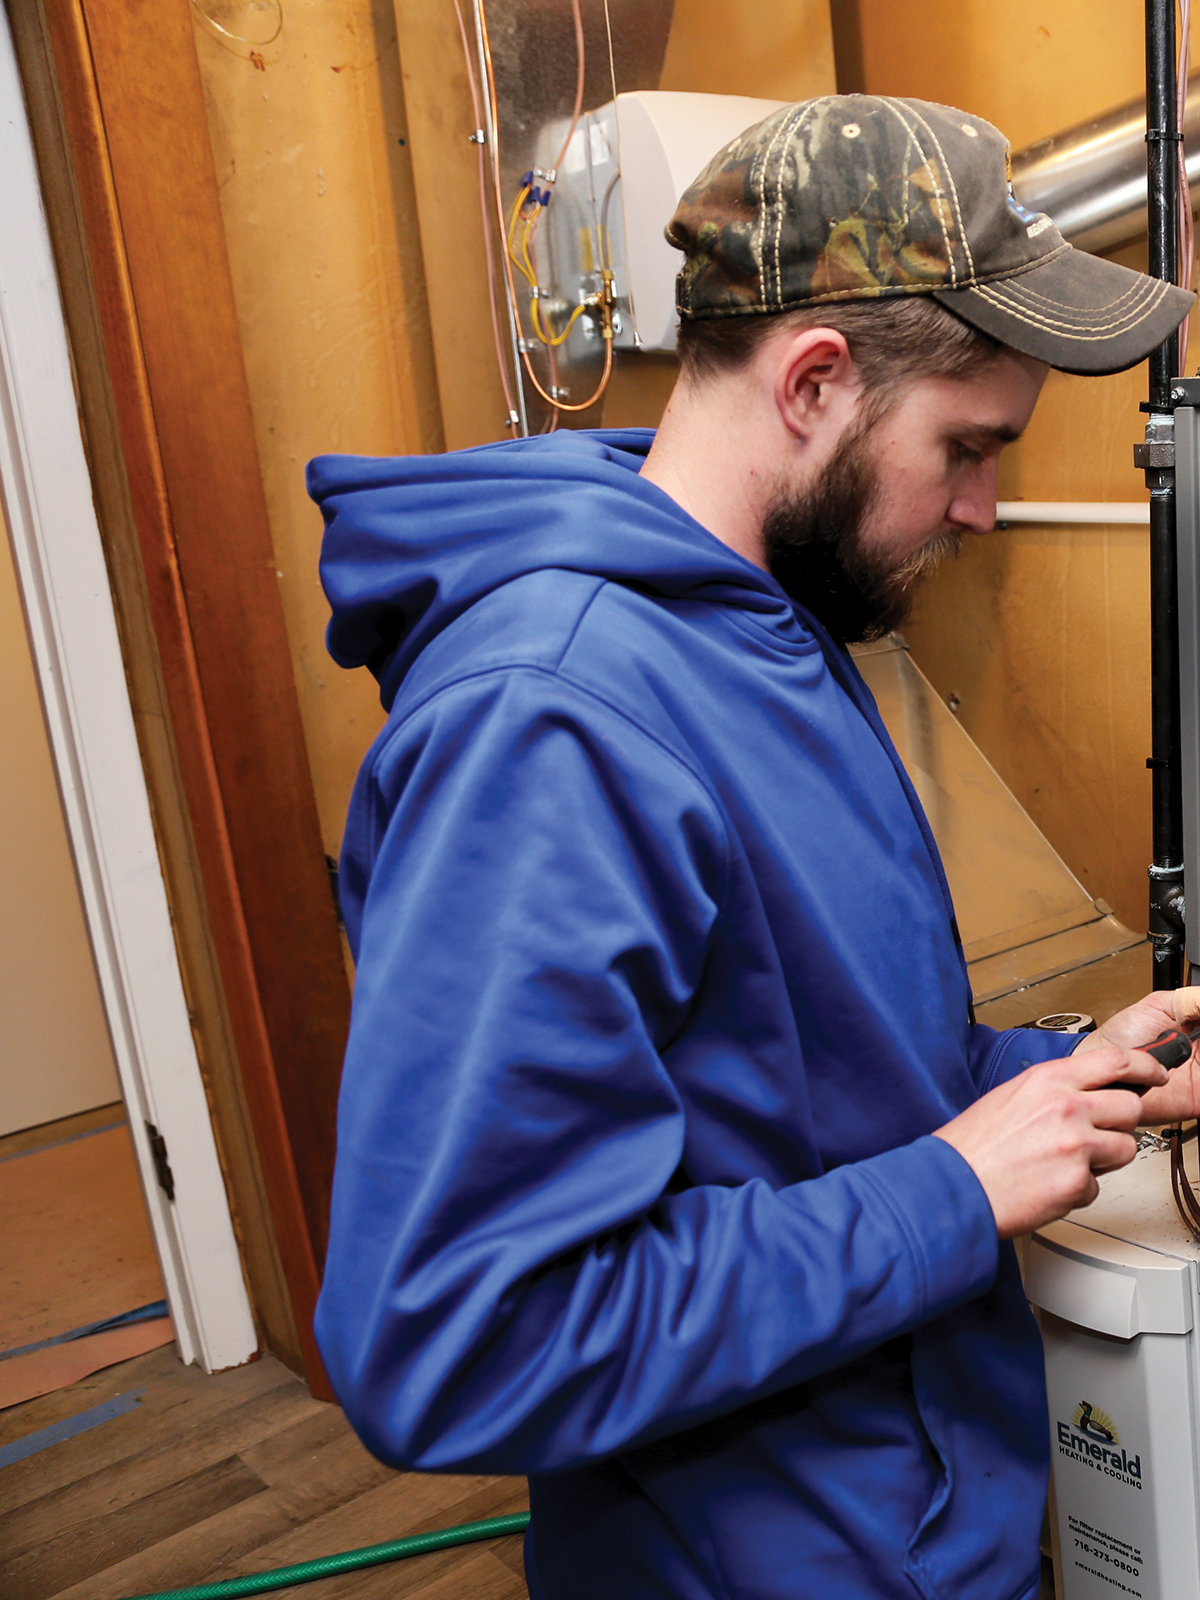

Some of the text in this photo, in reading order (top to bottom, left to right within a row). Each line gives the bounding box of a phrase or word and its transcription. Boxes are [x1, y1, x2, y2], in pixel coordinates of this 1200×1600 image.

[1057, 1421, 1142, 1480] Emerald
[1059, 1446, 1142, 1490] HEATING & COOLING
[1068, 1514, 1078, 1524] For
[1080, 1520, 1094, 1532] filter
[1094, 1530, 1133, 1552] replacement
[1068, 1524, 1109, 1548] maintenance,
[1110, 1544, 1130, 1558] please
[1074, 1538, 1140, 1577] 716-273-0800
[1075, 1560, 1142, 1598] emeraldheating.com
